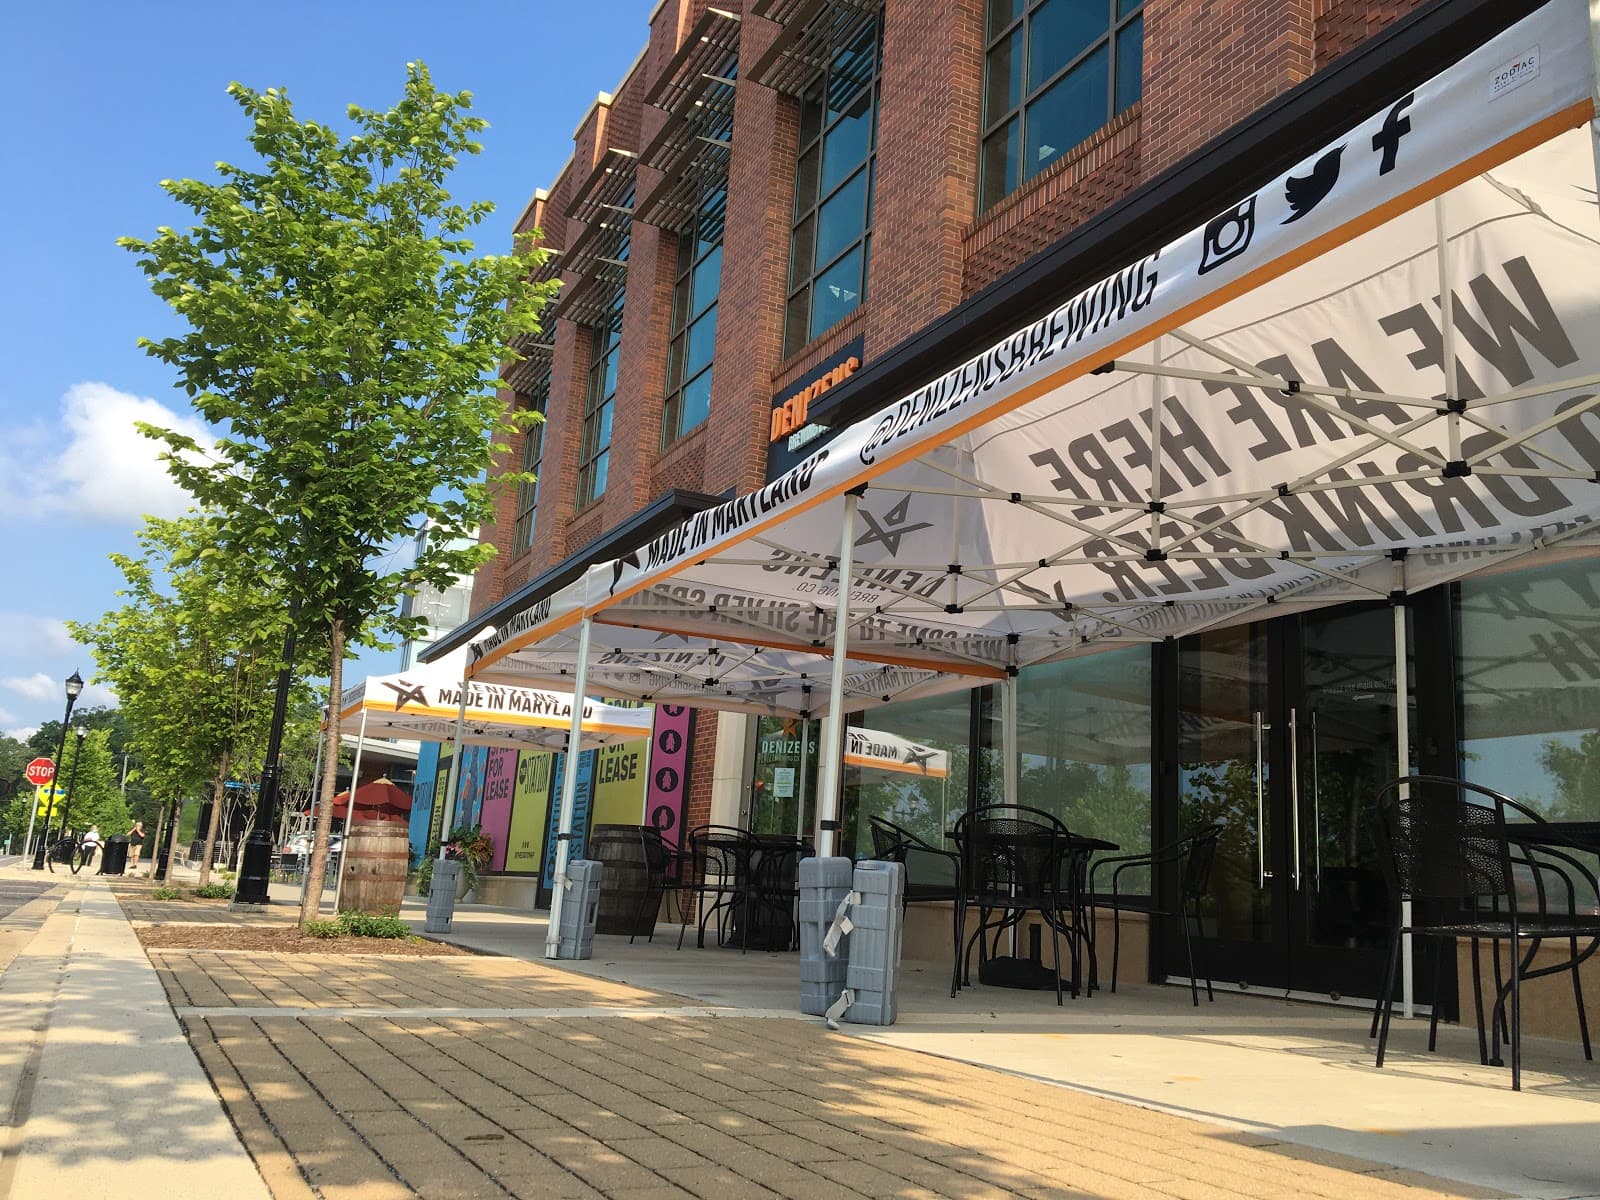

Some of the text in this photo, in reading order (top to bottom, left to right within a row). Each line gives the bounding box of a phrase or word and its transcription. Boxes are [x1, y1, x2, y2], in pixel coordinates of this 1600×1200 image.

[1495, 57, 1535, 84] ZODIAC
[644, 450, 829, 572] MADE IN MARYLAND
[438, 688, 484, 708] MADE
[488, 693, 504, 711] IN
[508, 695, 593, 719] MARYLAD
[762, 740, 816, 754] DENIZES
[29, 766, 55, 777] STOP
[488, 757, 504, 778] FOR
[599, 753, 638, 785] LEASE
[485, 779, 509, 800] LEASE
